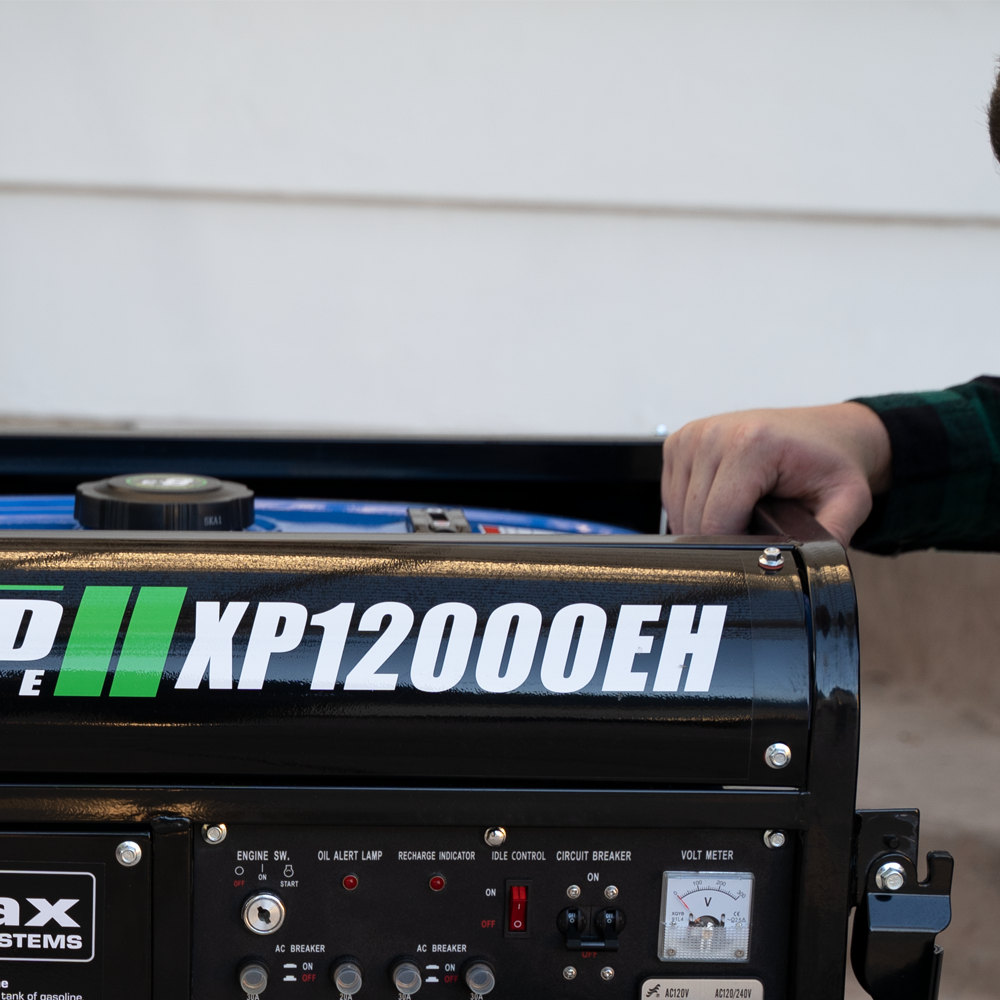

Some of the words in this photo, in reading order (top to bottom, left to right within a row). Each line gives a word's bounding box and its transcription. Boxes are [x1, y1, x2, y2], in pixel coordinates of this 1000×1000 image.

[174, 601, 728, 692] XP12000EH
[237, 850, 268, 861] ENGINE
[274, 850, 290, 861] SW.
[318, 850, 330, 861] OIL
[333, 850, 358, 861] ALERT
[361, 850, 383, 861] LAMP
[398, 851, 436, 860] RECHARGE
[439, 851, 475, 860] INDICATOR
[492, 851, 508, 861] IDLE
[511, 851, 546, 861] CONTROL
[556, 851, 589, 861] CIRCUIT
[592, 851, 631, 861] BREAKER
[681, 850, 702, 860] VOLT
[705, 850, 734, 860] METER
[258, 873, 267, 881] ON
[587, 872, 599, 882] ON
[485, 888, 496, 897] ON
[736, 890, 746, 899] 300
[704, 897, 712, 907] V
[481, 920, 495, 928] OFF
[275, 944, 285, 953] AC
[290, 944, 325, 953] BREAKER
[416, 944, 427, 952] AC
[432, 944, 467, 953] BREAKER
[302, 962, 313, 971] ON
[444, 963, 455, 972] ON
[302, 973, 316, 982] OFF
[444, 975, 458, 983] OFF
[1, 991, 24, 1000] tank
[27, 992, 37, 1000] of
[246, 993, 260, 1000] 30A
[339, 993, 353, 1000] 20A
[398, 993, 412, 1000] 30A
[470, 993, 484, 1000] 30A
[665, 988, 689, 998] AC120V
[715, 988, 752, 999] AC120/240V
